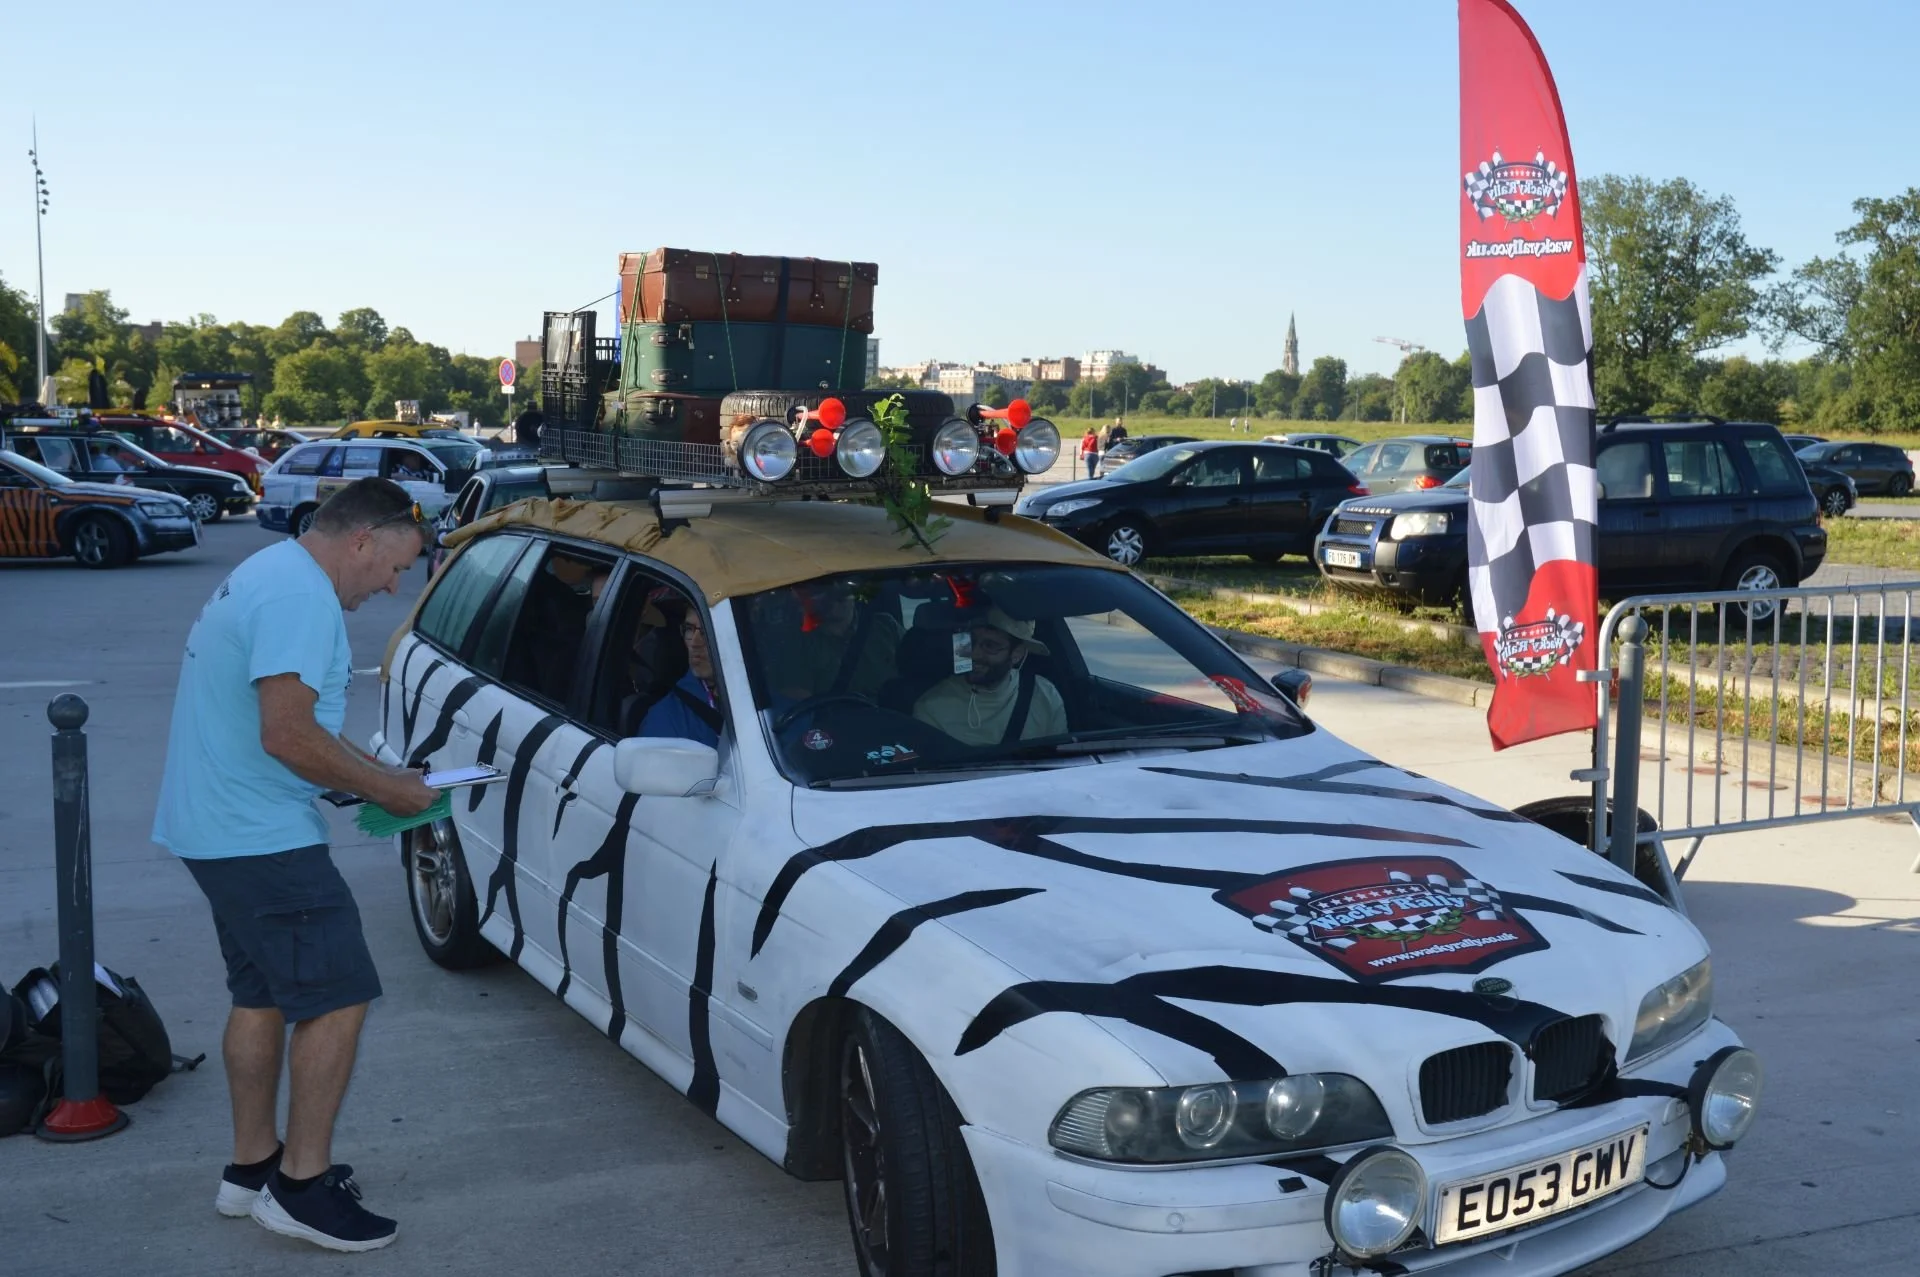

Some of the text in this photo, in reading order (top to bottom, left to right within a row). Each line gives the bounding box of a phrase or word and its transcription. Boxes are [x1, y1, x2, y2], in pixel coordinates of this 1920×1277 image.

[1313, 892, 1466, 930] Wacky Rally
[1368, 932, 1518, 967] www.wackyrally.co.uk
[1571, 1134, 1636, 1198] GWV
